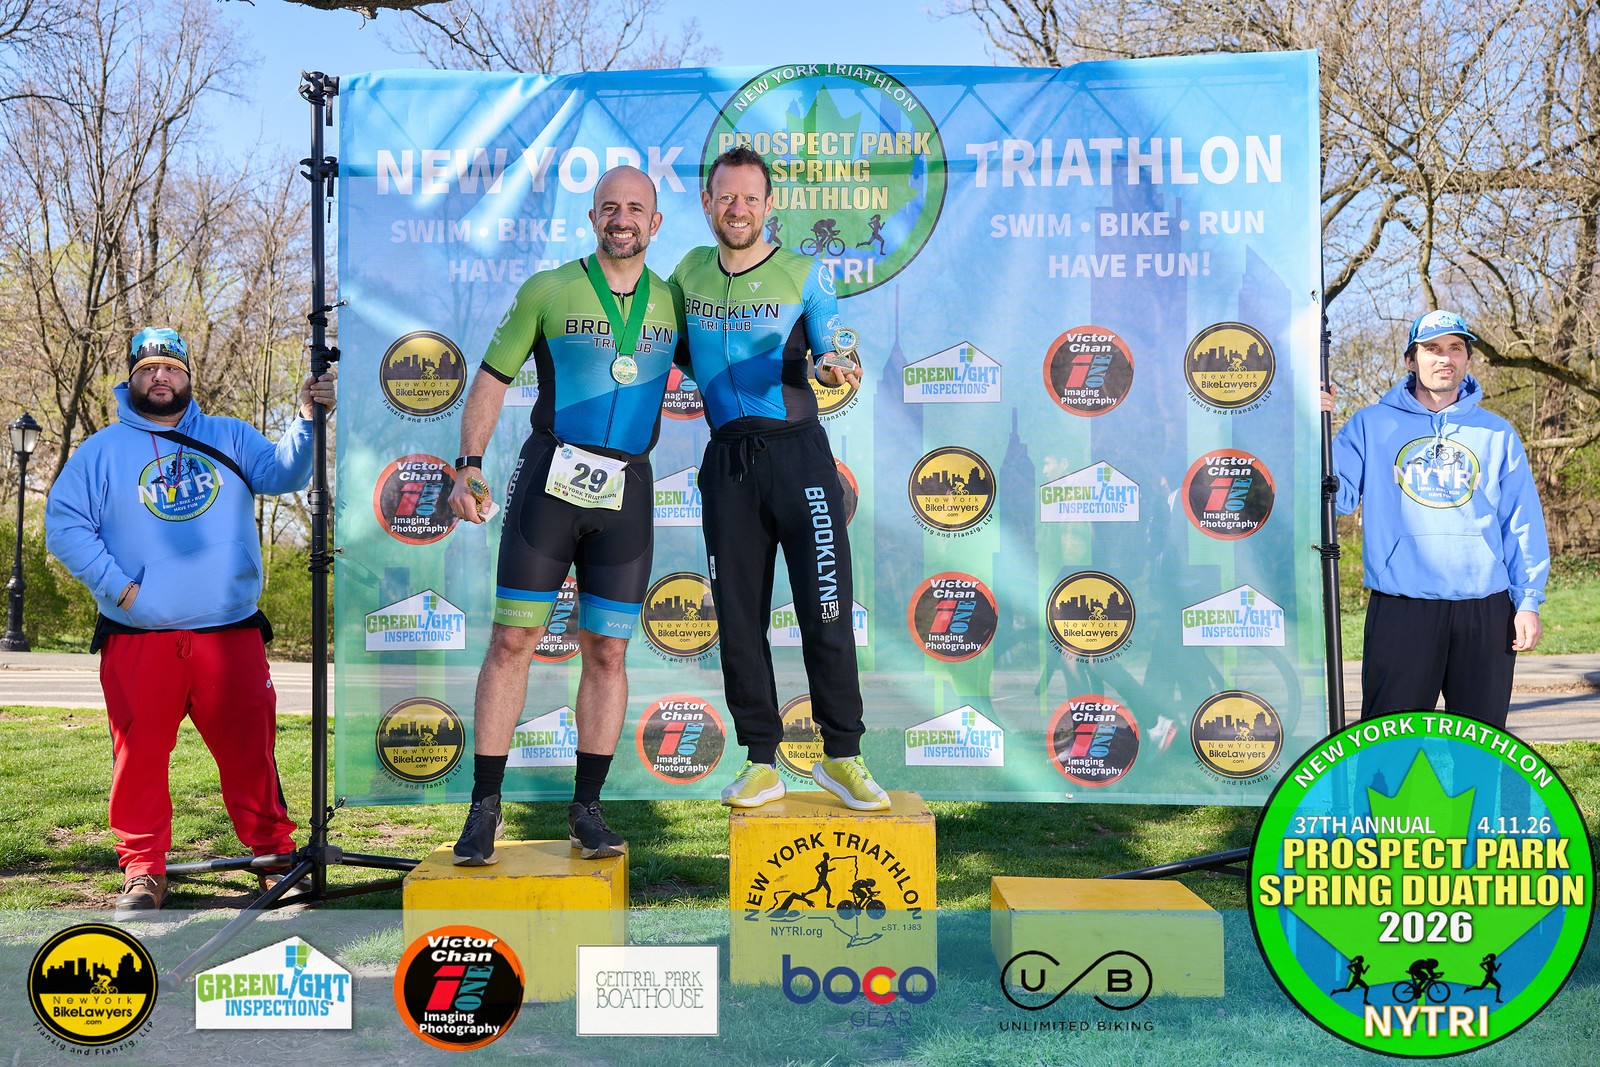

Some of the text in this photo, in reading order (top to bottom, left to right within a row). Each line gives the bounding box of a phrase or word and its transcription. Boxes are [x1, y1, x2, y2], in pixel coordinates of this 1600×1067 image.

[733, 63, 918, 113] NEW YORK TRIATHLON
[718, 132, 931, 155] PROSPECT PARK
[966, 135, 1281, 188] TRIATHLON
[377, 148, 507, 195] NEW
[771, 160, 870, 182] SPRING
[773, 187, 888, 209] UATHLON
[990, 210, 1264, 238] SWIM BIKE RUN
[390, 219, 566, 243] SWIM BIKE
[1050, 252, 1210, 278] HAVE FUN!
[449, 259, 522, 283] HAVE
[700, 320, 751, 331] TRI CLUB
[565, 319, 673, 344] BROLYN
[594, 337, 615, 348] TRI
[1066, 334, 1115, 342] Victor
[1069, 344, 1111, 352] Chan
[905, 364, 999, 386] GREENLIGHT
[922, 384, 986, 394] INSPECTIONS
[1202, 381, 1257, 389] BikeLawyers
[396, 389, 449, 397] BikeLawyers
[1065, 388, 1099, 397] Imaging
[1061, 397, 1117, 406] Photography
[1205, 457, 1255, 465] Victor
[397, 462, 446, 471] Victor
[1208, 467, 1251, 476] Chan
[399, 472, 442, 481] Chan
[570, 463, 608, 493] 29
[1394, 464, 1482, 490] NYTRI
[138, 469, 224, 504] NYTRI
[554, 481, 567, 489] NEW
[568, 487, 583, 497] YORK
[585, 492, 616, 500] TRIATHLON
[1042, 484, 1137, 504] GREENLIGHT
[926, 504, 978, 512] BikeLawyers
[1059, 503, 1124, 513] INSPECTIONS
[394, 516, 430, 525] Imaging
[1204, 511, 1239, 520] Imaging
[391, 525, 448, 534] Photography
[1200, 520, 1258, 529] Photography
[805, 486, 838, 601] BROOKLYN
[930, 579, 979, 588] Victor
[933, 590, 975, 598] Chan
[821, 600, 838, 612] TRI
[496, 608, 533, 618] BROOKLYN
[822, 610, 839, 619] CLUB
[1184, 606, 1282, 628] GREENLIGHT
[367, 612, 463, 633] GREENLIGHT
[385, 631, 451, 642] INSPECTIONS
[658, 630, 710, 638] BikeLawyers
[1064, 629, 1118, 638] BikeLawyers
[1202, 627, 1270, 637] INSPECTIONS
[929, 633, 963, 643] Imaging
[925, 642, 981, 651] Photography
[659, 702, 707, 710] Victor
[1069, 702, 1119, 711] Victor
[661, 712, 703, 720] Chan
[1072, 713, 1116, 722] Chan
[907, 728, 1001, 748] GREENLIGHT
[924, 747, 989, 758] INSPECTIONS
[1209, 750, 1265, 759] BikeLawyers
[393, 755, 448, 763] BikeLawyers
[657, 755, 691, 764] Imaging
[1068, 758, 1104, 767] Imaging
[654, 764, 709, 773] Photography
[1065, 766, 1122, 776] Photography
[745, 832, 923, 922] NEW YORK TRIATHLON
[771, 927, 822, 937] NYTRI.org
